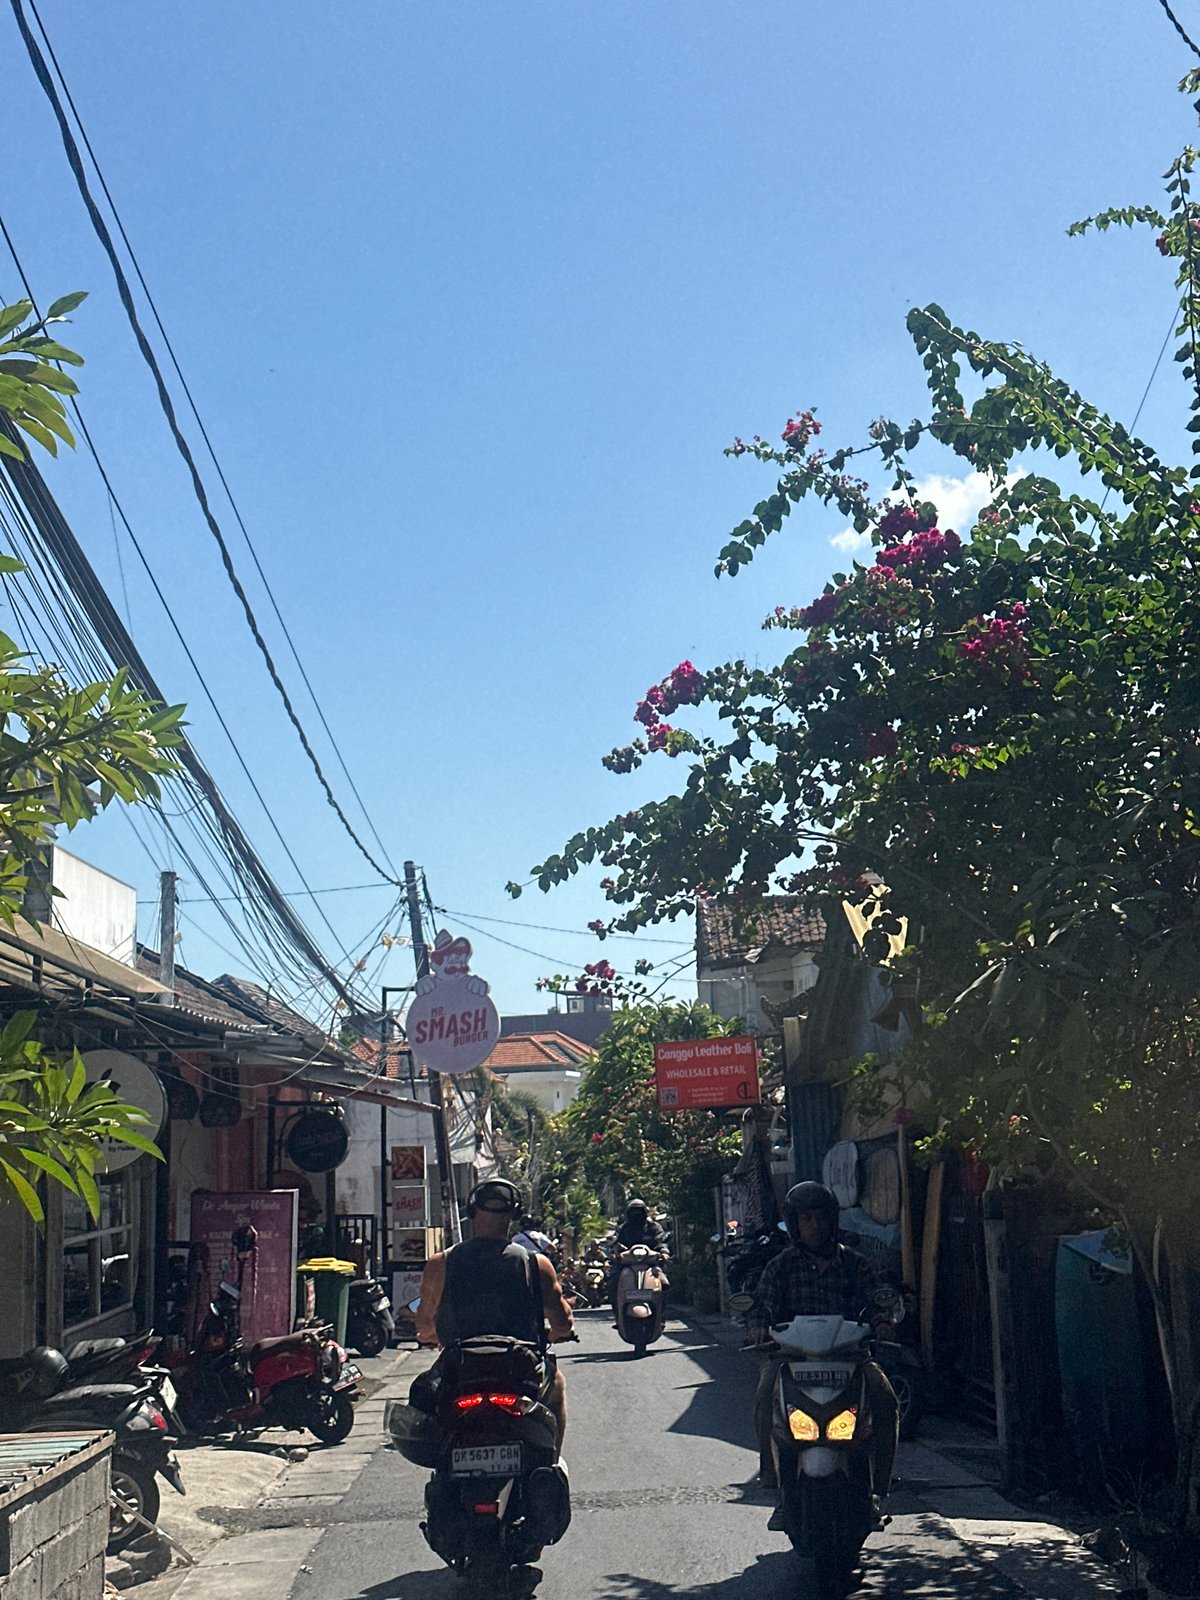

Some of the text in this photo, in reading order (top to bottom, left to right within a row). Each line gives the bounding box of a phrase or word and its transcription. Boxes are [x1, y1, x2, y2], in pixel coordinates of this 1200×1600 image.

[415, 1007, 487, 1043] SMASH
[453, 1031, 488, 1047] BURGER
[658, 1042, 752, 1061] Canggu Leather Bali
[666, 1065, 746, 1079] WHOLESALE & RETAIL
[454, 1450, 468, 1463] DK
[469, 1448, 495, 1461] 5637
